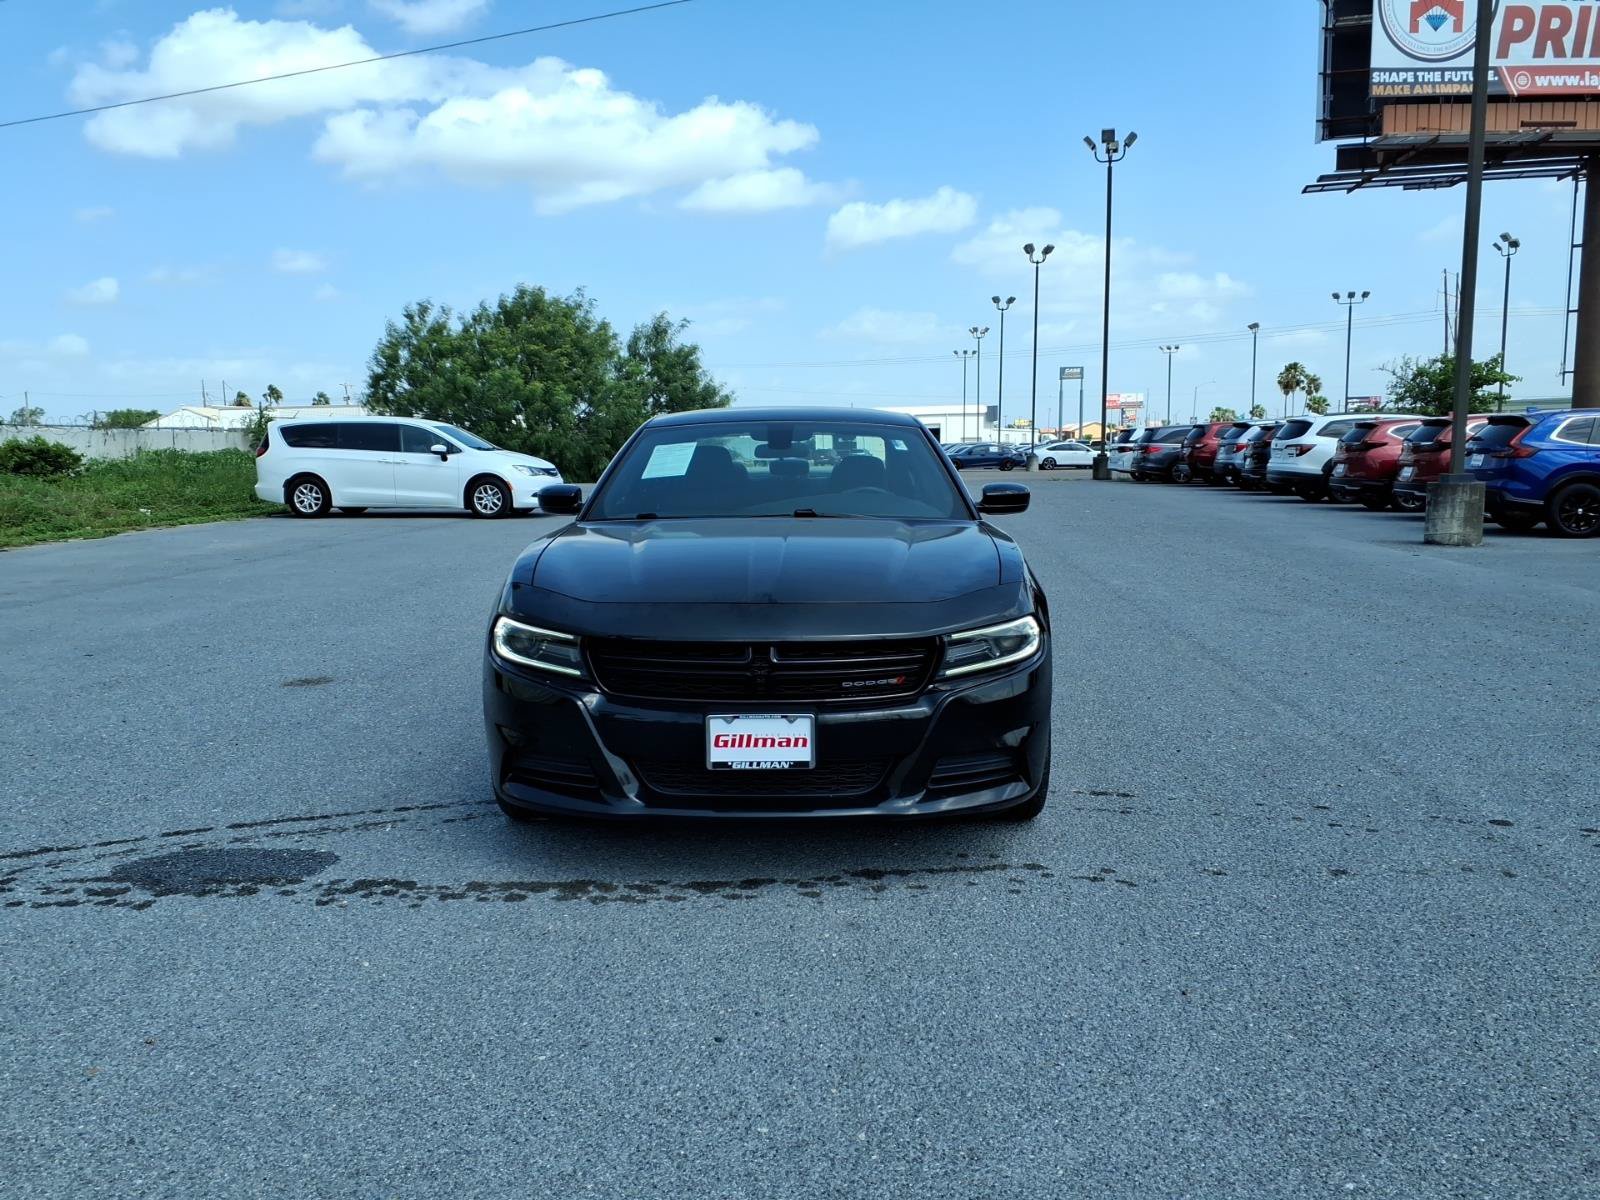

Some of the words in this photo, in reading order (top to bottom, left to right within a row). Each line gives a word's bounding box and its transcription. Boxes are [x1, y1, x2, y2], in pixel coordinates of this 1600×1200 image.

[1372, 71, 1414, 83] SHAPE
[1416, 71, 1441, 82] THE
[1444, 70, 1499, 82] FUTUE.
[1372, 84, 1411, 95] MAKE
[1413, 84, 1433, 94] AN
[1435, 83, 1473, 94] IMPA
[714, 734, 808, 748] Gillman
[732, 761, 789, 769] GILLMAN
